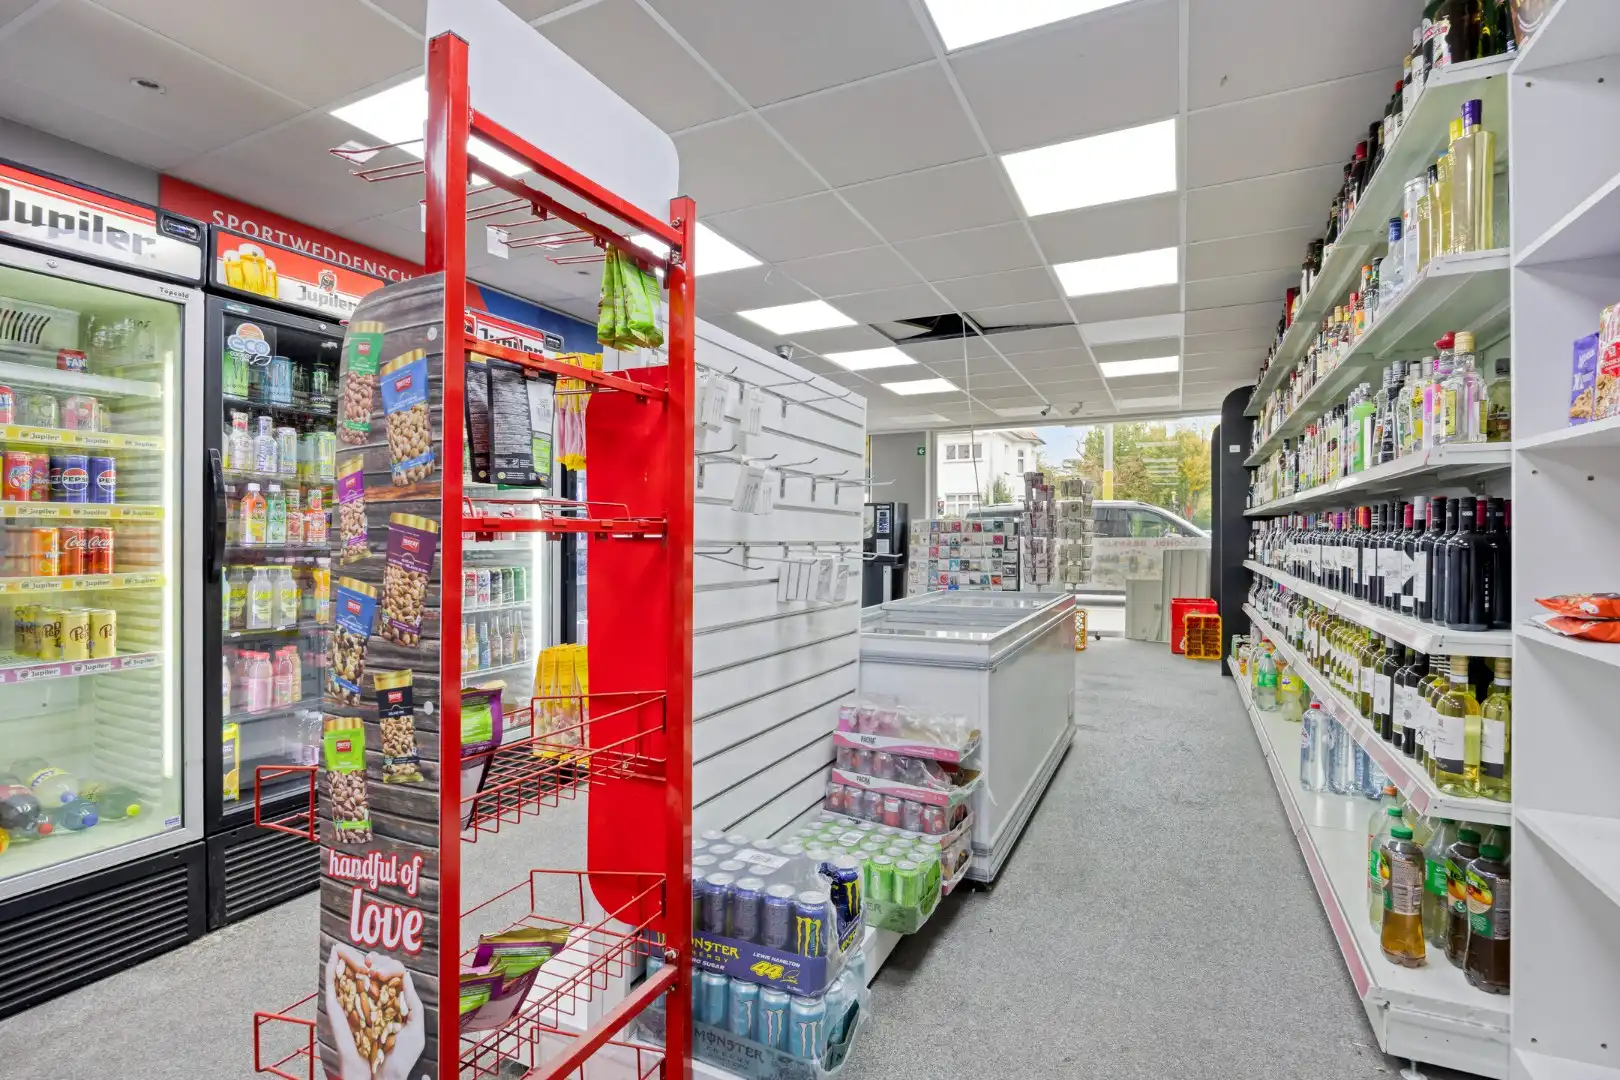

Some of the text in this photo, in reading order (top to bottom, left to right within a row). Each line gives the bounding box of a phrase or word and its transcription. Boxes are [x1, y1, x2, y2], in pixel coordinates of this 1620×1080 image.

[296, 285, 357, 312] Jupiler
[329, 850, 422, 894] handful of
[350, 887, 423, 952] love
[702, 960, 725, 970] SUGAR
[750, 960, 784, 980] 44
[771, 957, 801, 968] HAMILTON
[694, 1027, 764, 1064] MONSTER
